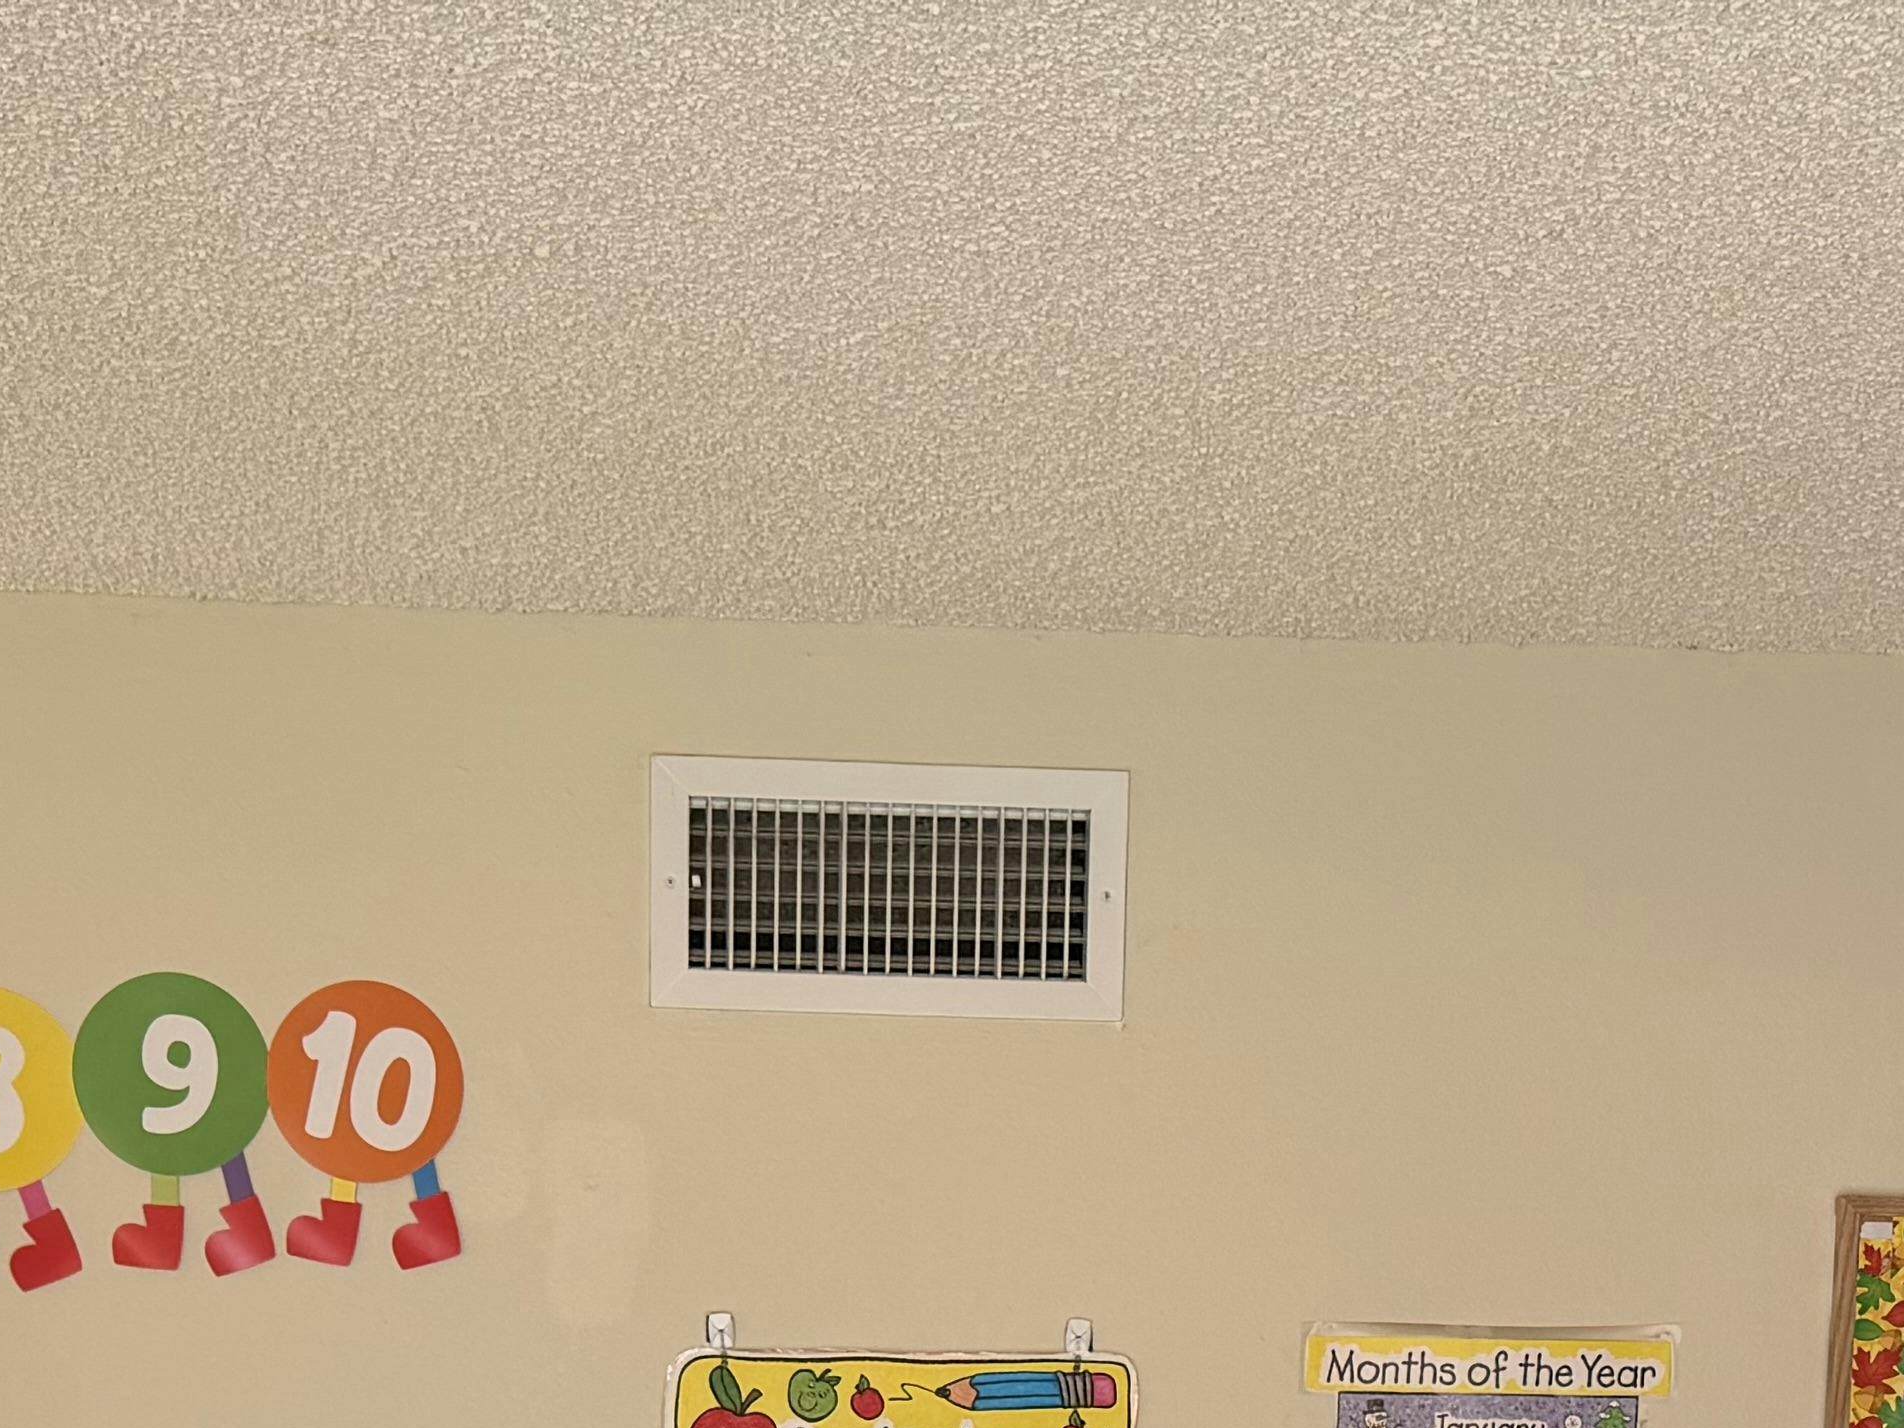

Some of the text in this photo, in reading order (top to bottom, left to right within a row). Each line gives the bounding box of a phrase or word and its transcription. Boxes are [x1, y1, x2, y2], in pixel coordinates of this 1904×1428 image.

[139, 1013, 219, 1135] 9
[301, 1009, 437, 1153] 10
[1326, 1349, 1656, 1389] Months of the Year
